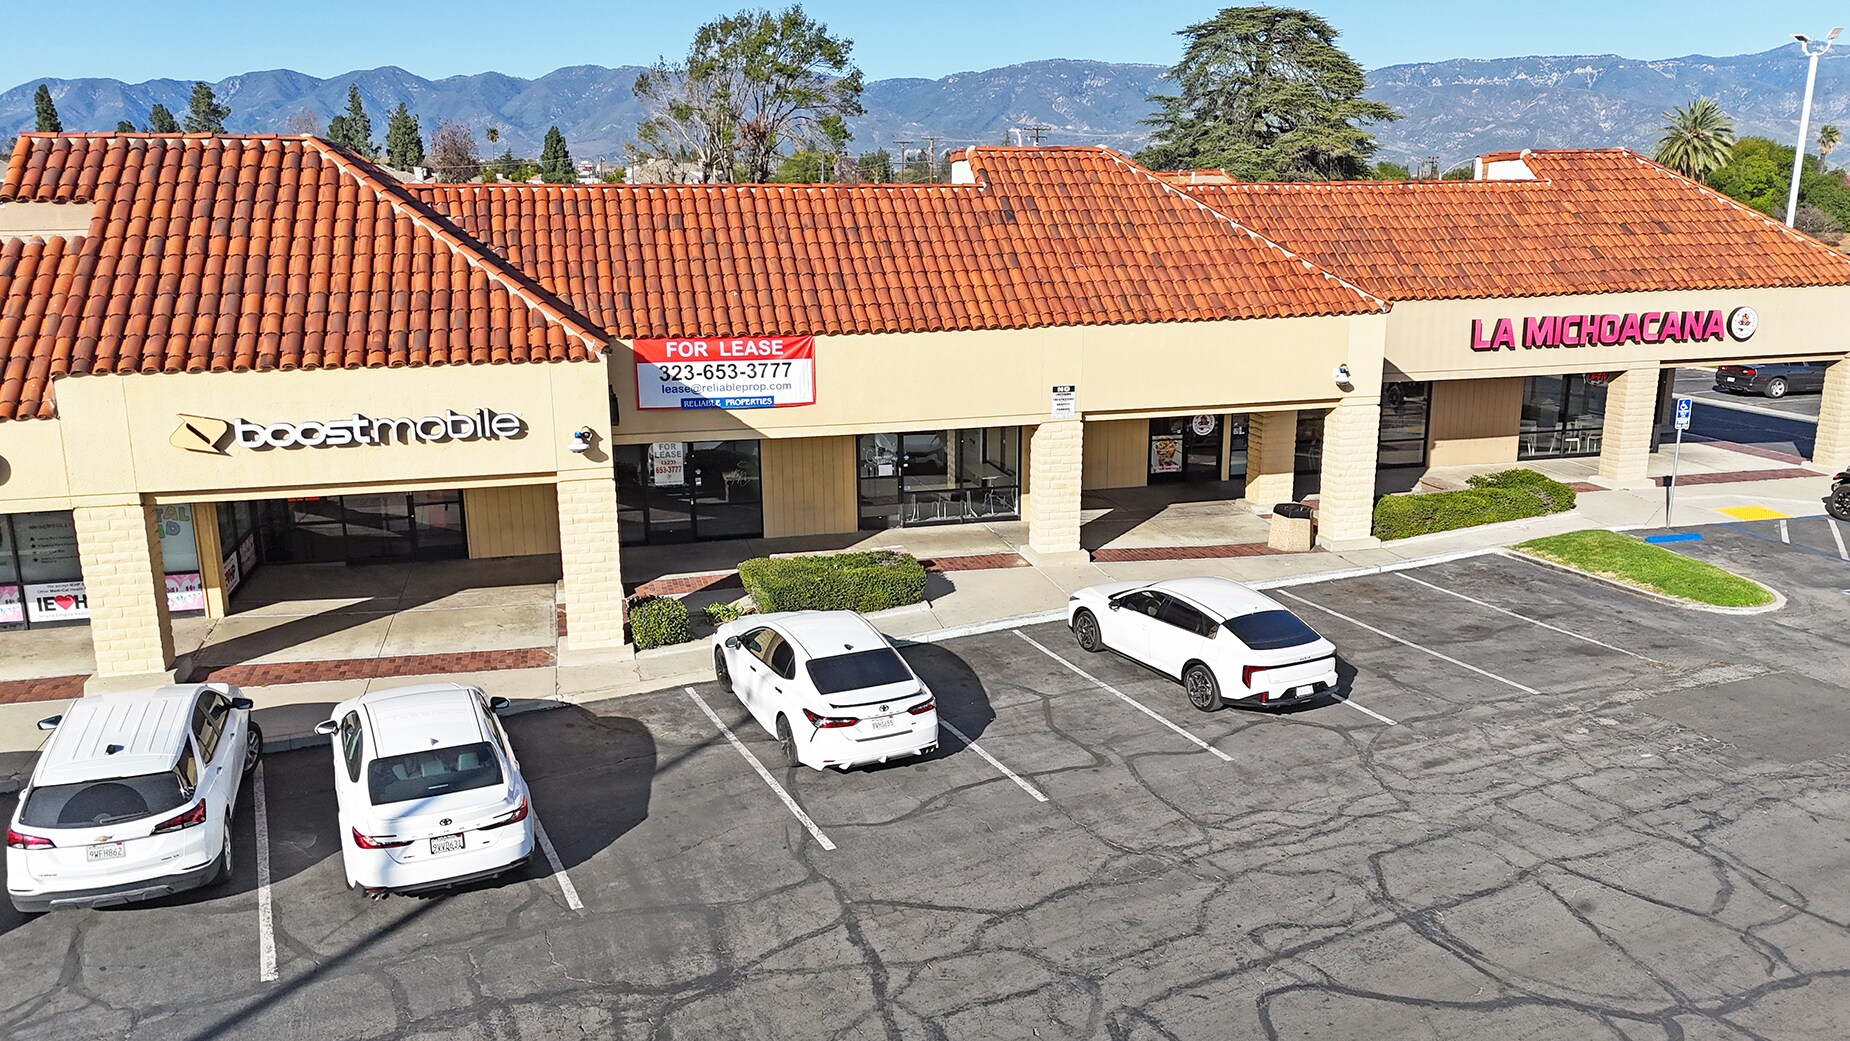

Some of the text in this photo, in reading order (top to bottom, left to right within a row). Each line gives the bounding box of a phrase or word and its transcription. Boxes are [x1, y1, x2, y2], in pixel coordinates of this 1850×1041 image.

[1471, 318, 1515, 351] LA
[1522, 310, 1725, 349] MICHOACANA
[666, 340, 784, 358] FOR LEASE
[659, 362, 792, 382] 323-653-3777
[661, 382, 792, 395] lease@reliableprop.com
[683, 397, 773, 408] RELIABLE PROPERTIES
[659, 443, 676, 451] FOR
[654, 451, 682, 459] LEASE
[655, 466, 682, 474] 653-3777
